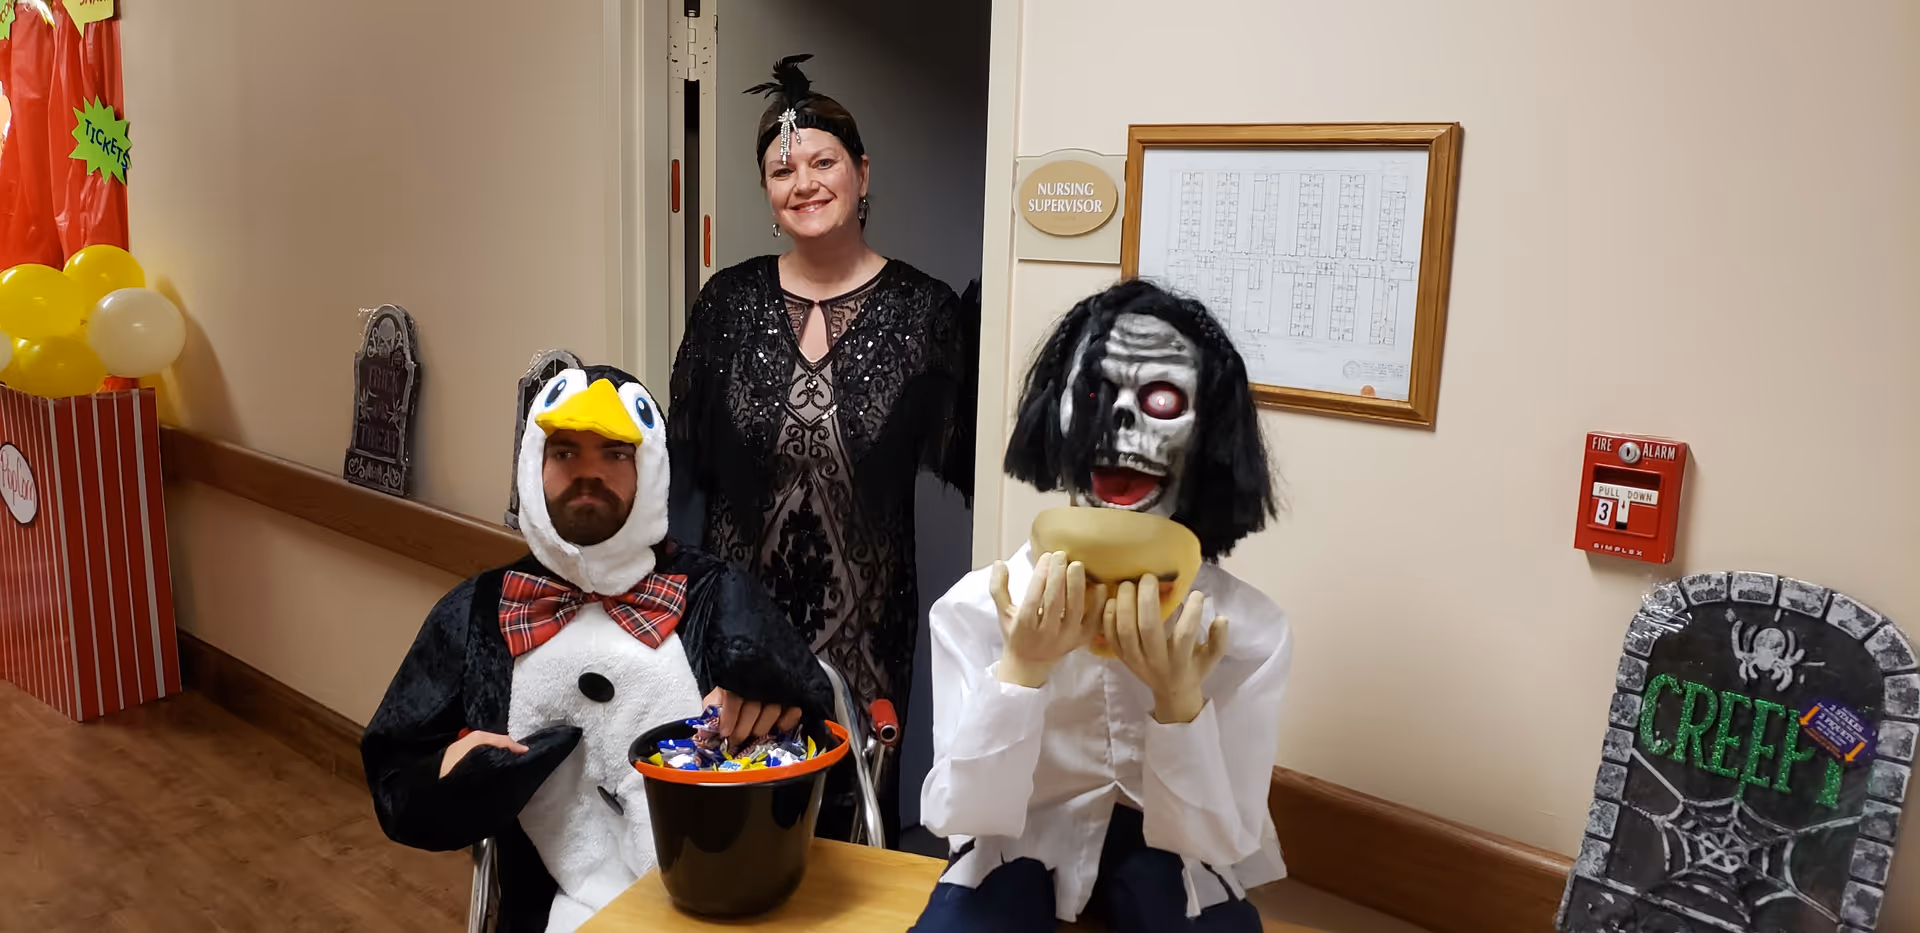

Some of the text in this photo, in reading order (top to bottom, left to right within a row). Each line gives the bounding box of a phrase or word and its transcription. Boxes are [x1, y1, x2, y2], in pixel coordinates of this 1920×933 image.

[85, 119, 130, 168] TICKETS
[1037, 182, 1094, 196] NURSING
[1028, 198, 1103, 213] SUPERVISOR
[360, 423, 400, 453] TREAT
[1592, 436, 1676, 460] FIRE ALARM
[1598, 485, 1653, 502] PULL DOWN
[1598, 502, 1609, 521] 3
[1593, 542, 1643, 556] SIMPLEX
